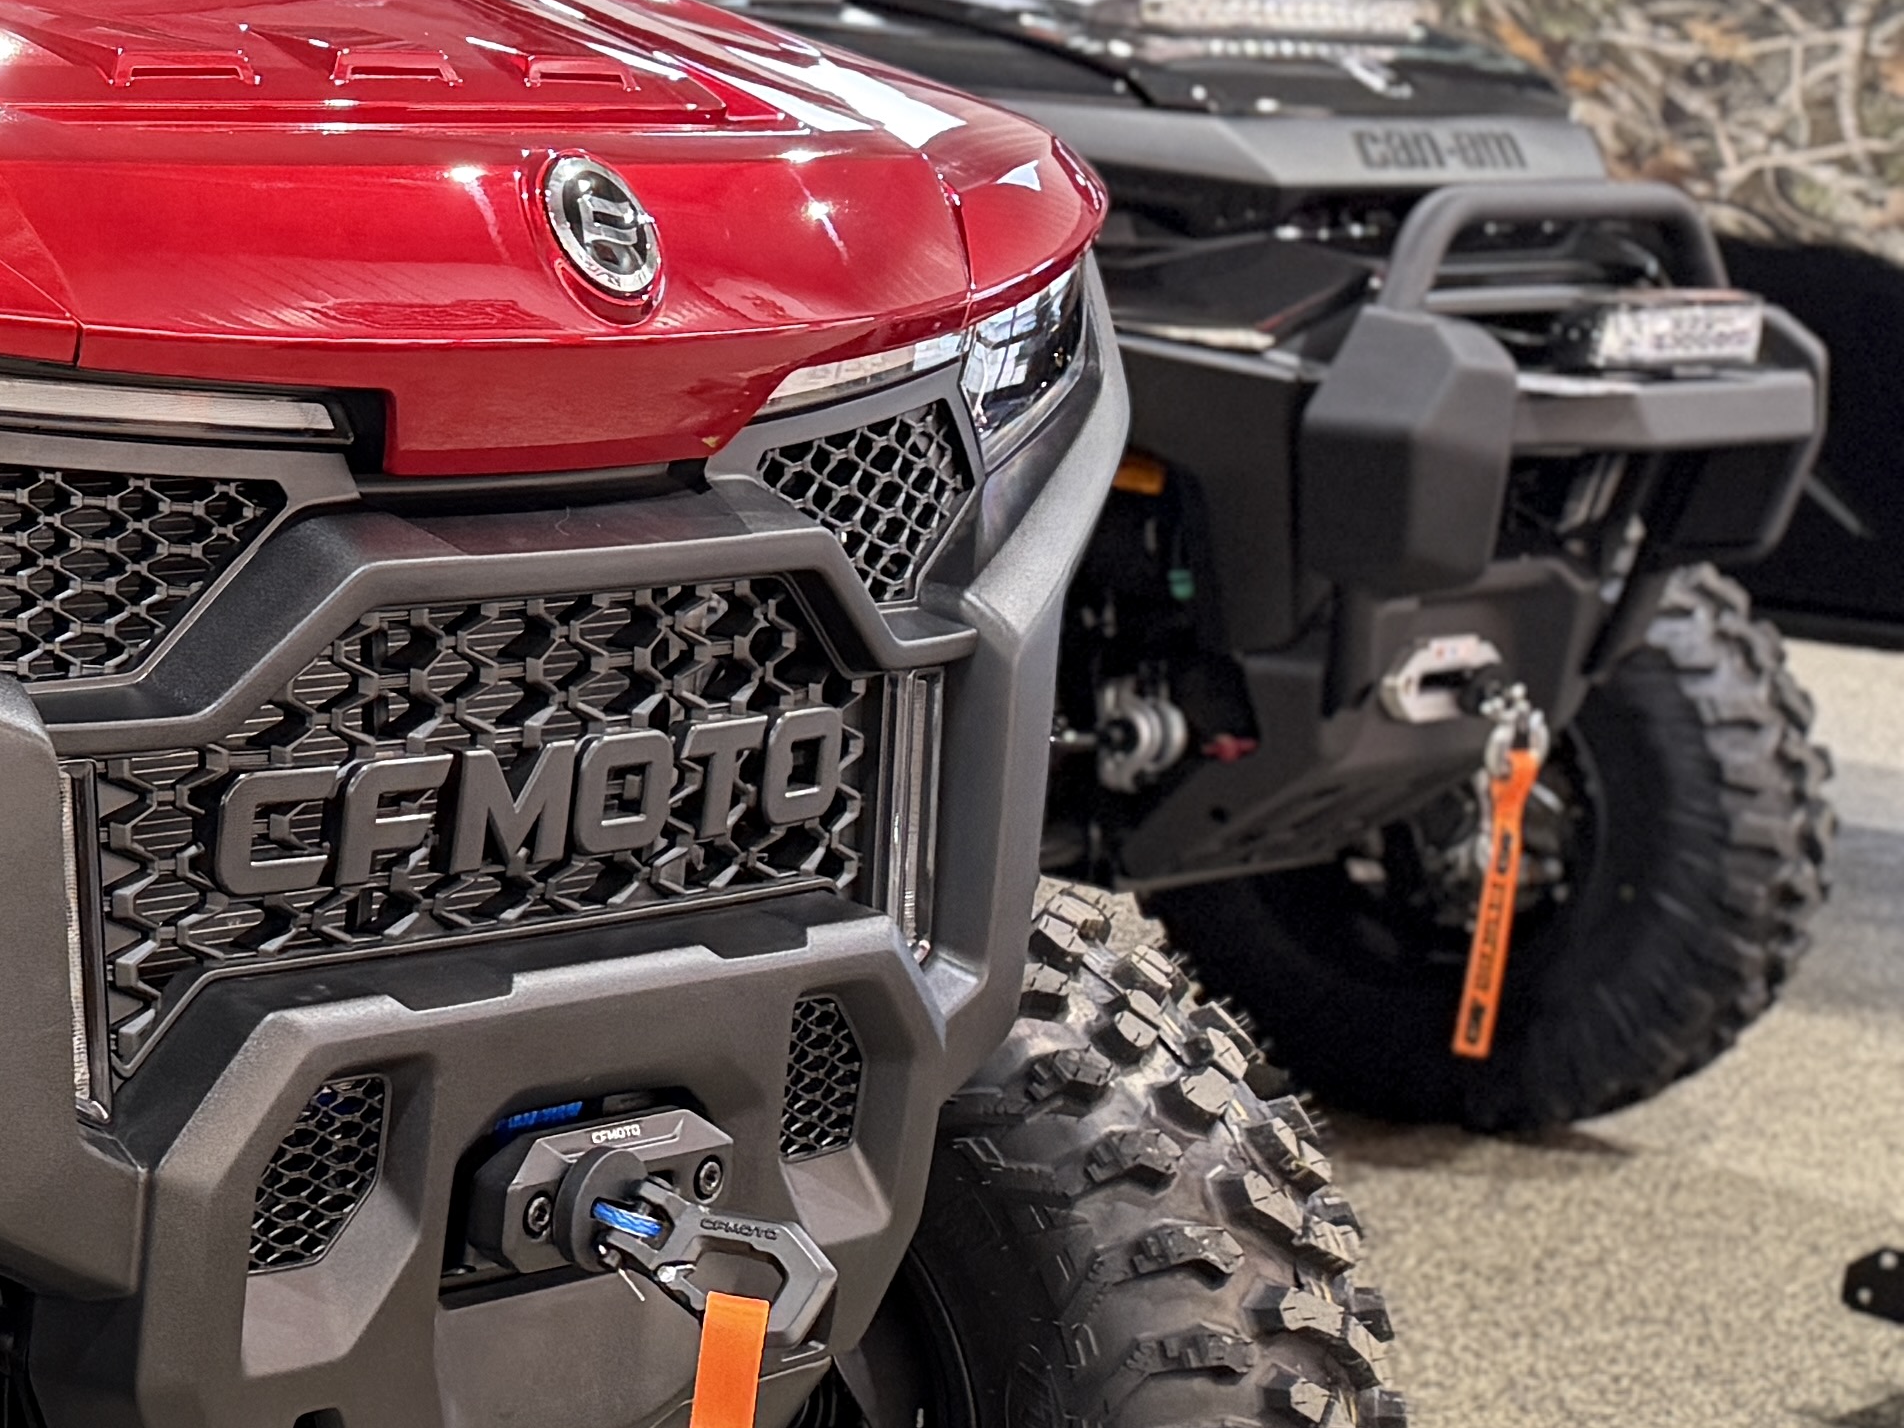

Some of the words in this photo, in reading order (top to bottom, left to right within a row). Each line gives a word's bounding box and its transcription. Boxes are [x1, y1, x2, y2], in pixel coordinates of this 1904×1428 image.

[214, 706, 844, 896] CFMOTO
[592, 1124, 641, 1144] CFMOTO
[699, 1217, 778, 1241] CFMOTO
